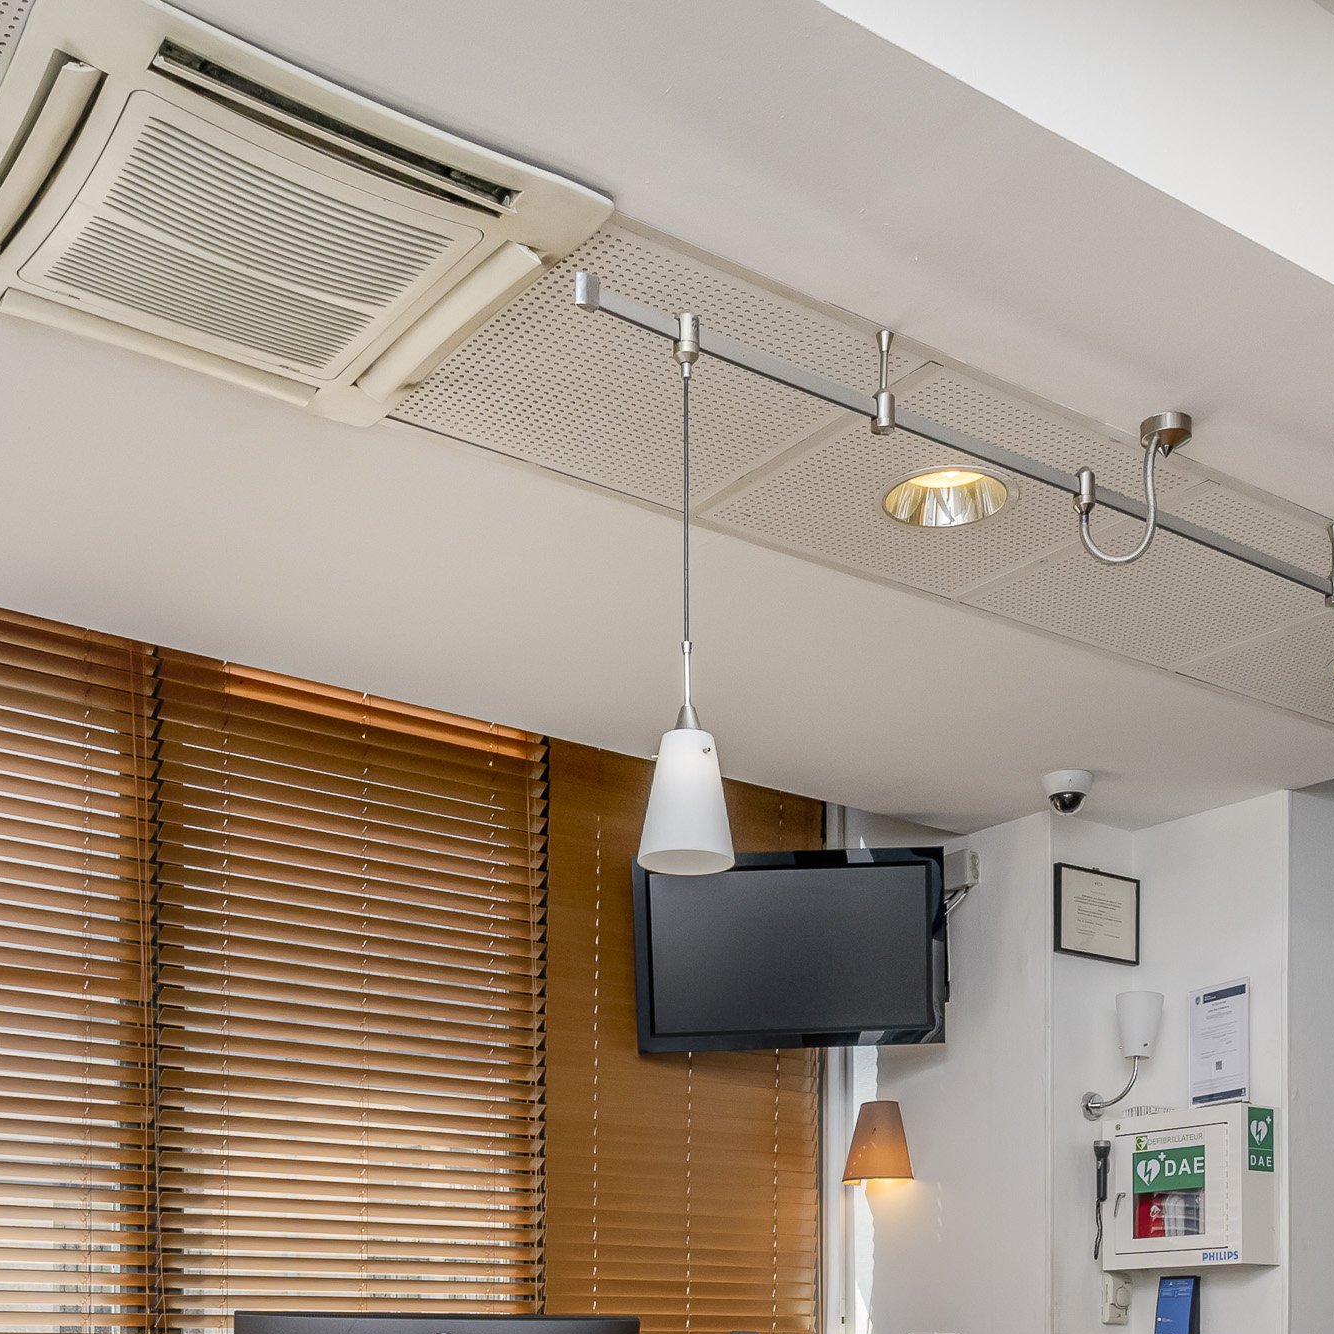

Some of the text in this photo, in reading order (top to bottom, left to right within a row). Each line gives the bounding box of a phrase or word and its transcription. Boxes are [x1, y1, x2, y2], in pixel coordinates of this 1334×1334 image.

[1164, 1156, 1205, 1177] DAE
[1250, 1154, 1272, 1167] DAE
[1202, 1251, 1239, 1261] PHILIPS
